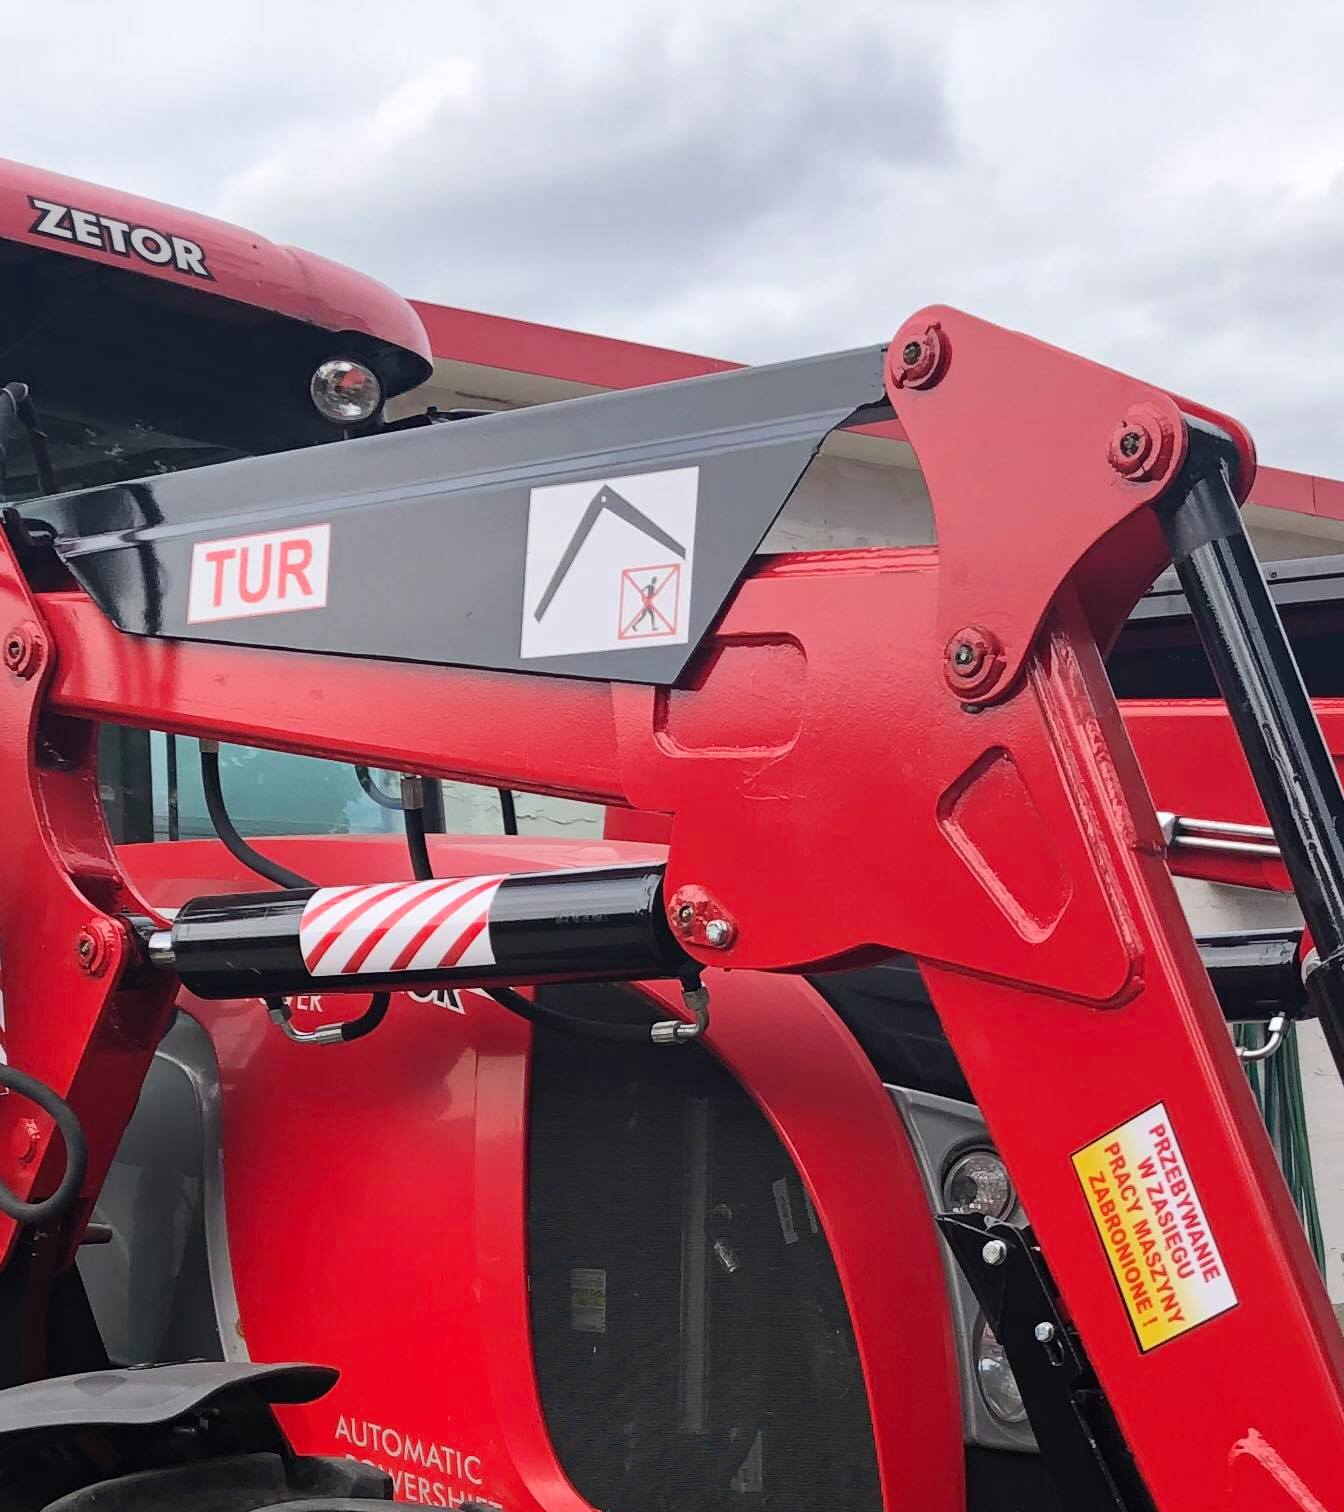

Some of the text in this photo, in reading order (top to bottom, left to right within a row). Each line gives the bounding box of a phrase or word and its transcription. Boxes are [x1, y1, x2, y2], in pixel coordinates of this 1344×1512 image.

[30, 198, 211, 278] ZETOR
[205, 538, 314, 608] TUR
[1136, 1156, 1156, 1180] W
[1148, 1122, 1222, 1284] PRZEBYWANIE
[1088, 1169, 1154, 1315] ZABRONIONE
[1103, 1140, 1186, 1324] PRACY MASZYNY
[334, 1413, 483, 1485] AUTOMATIC
